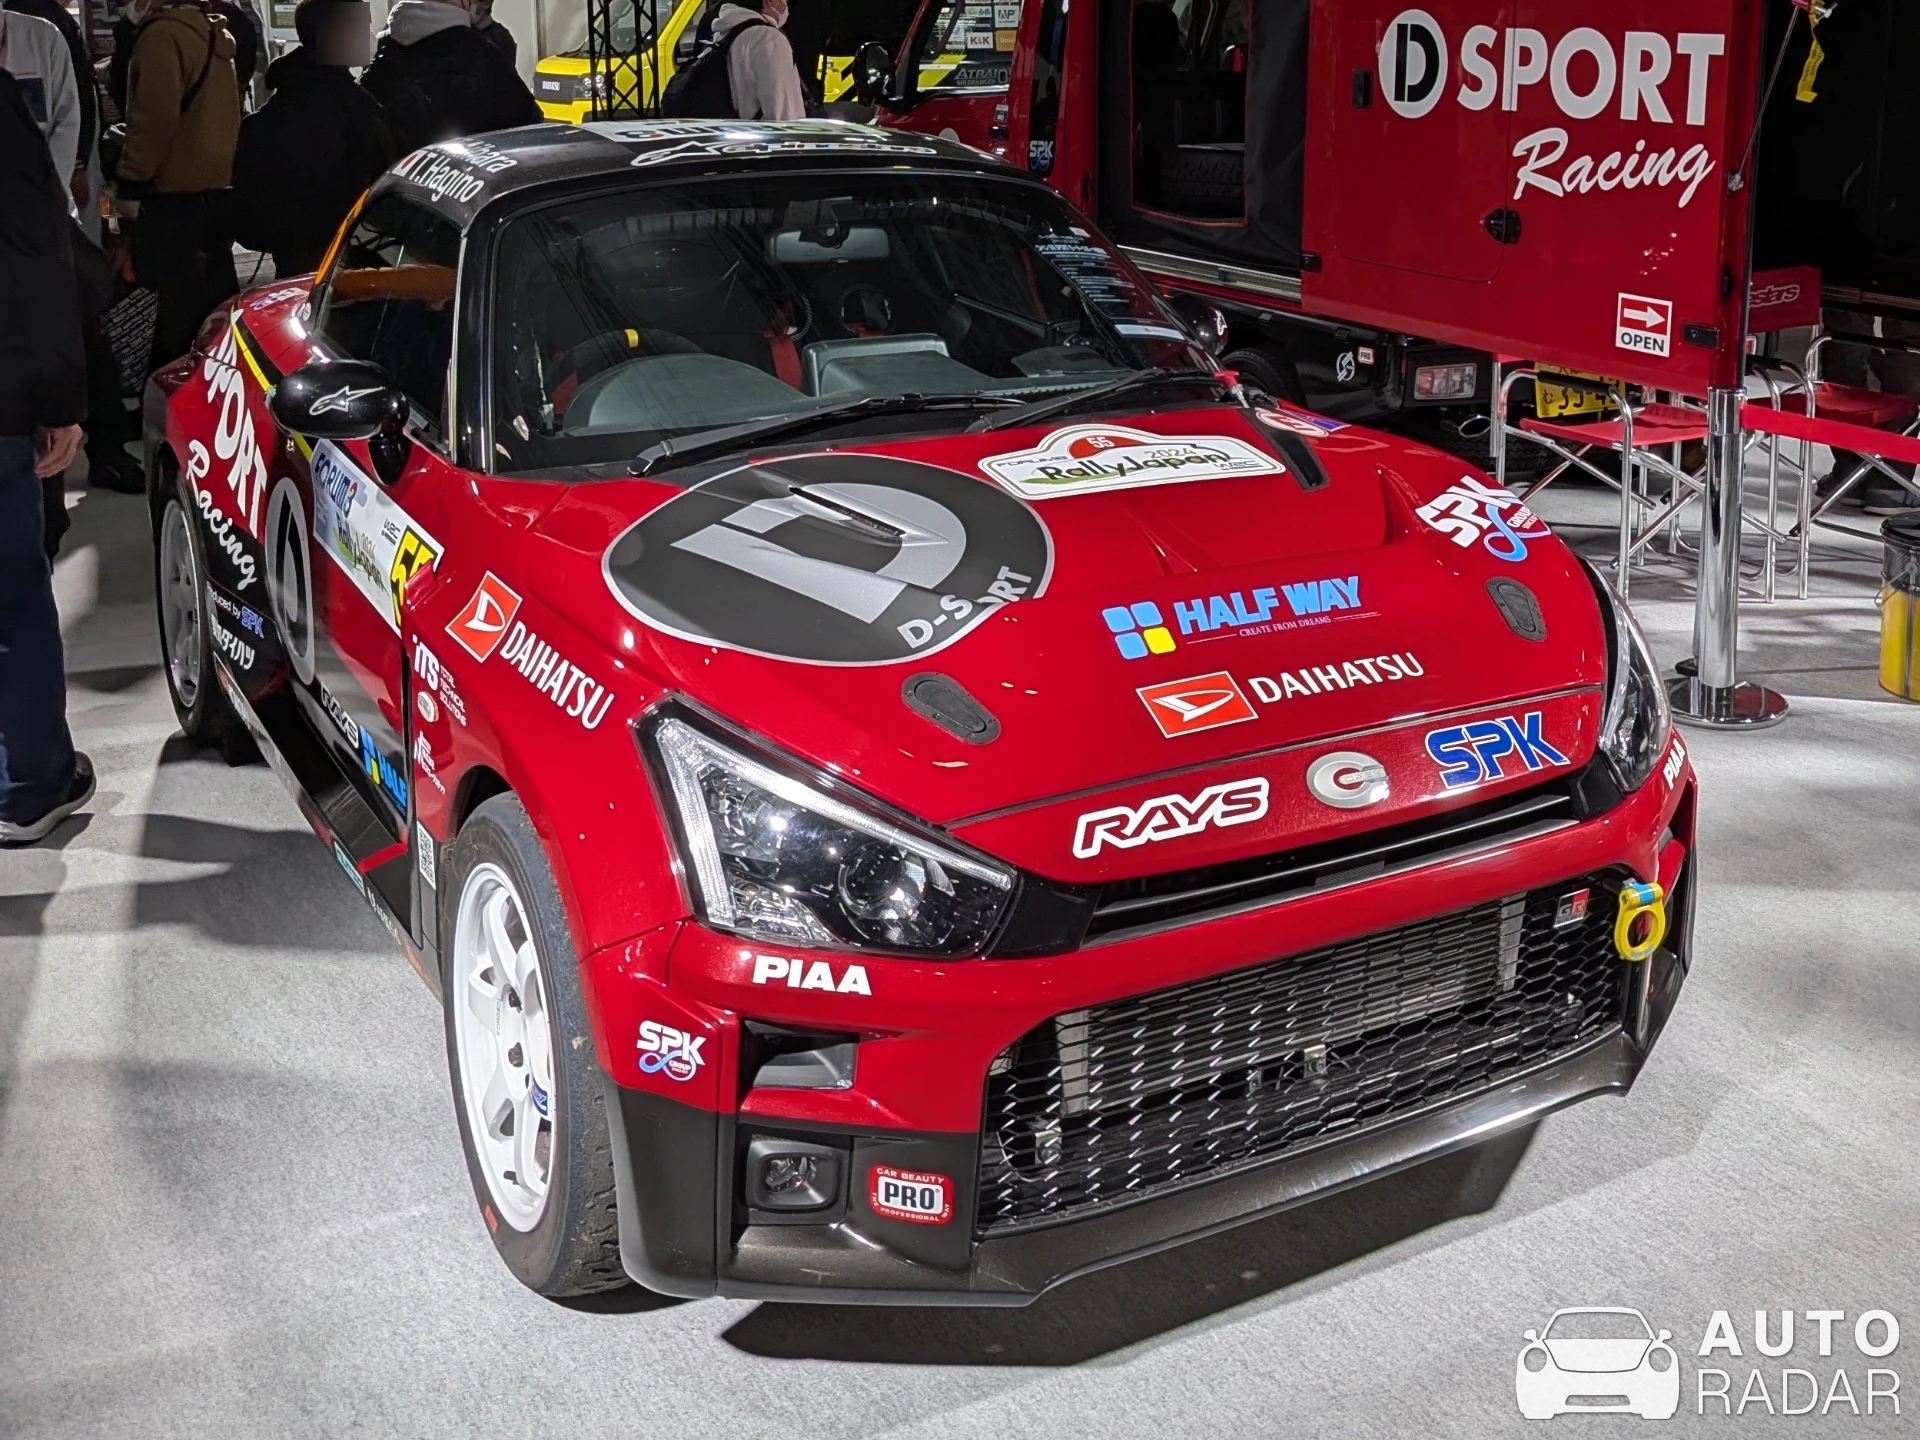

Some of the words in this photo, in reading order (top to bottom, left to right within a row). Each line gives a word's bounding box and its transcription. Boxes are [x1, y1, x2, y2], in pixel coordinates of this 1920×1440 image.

[1456, 24, 1725, 126] SPORT
[1029, 140, 1054, 158] SPK
[1512, 127, 1716, 208] Racing
[408, 152, 484, 202] T.Hagino
[1620, 332, 1665, 353] OPEN
[1085, 435, 1115, 449] 55
[1143, 447, 1194, 459] 2024
[186, 440, 258, 591] Racing
[1415, 475, 1518, 548] SPK
[241, 605, 264, 639] SPK
[1174, 588, 1279, 634] HALF
[1281, 576, 1362, 616] WAY
[1239, 624, 1272, 638] CREATE
[1273, 620, 1298, 632] FROM
[1299, 615, 1332, 628] DREAMS
[439, 664, 456, 689] TOTAL
[440, 677, 466, 713] TECHNICAL
[499, 620, 615, 730] DAIHATSU
[1248, 652, 1425, 704] DAIHATSU
[320, 681, 359, 749] RAYS
[440, 690, 467, 727] SOLUTIONS
[1425, 711, 1571, 789] SPK
[1663, 738, 1686, 791] PIAA
[377, 749, 407, 808] HALF
[1073, 777, 1269, 859] RAYS
[752, 955, 872, 996] PIAA
[637, 1020, 706, 1066] SPK
[877, 1167, 898, 1178] CAR
[901, 1172, 945, 1184] BEAUTY
[884, 1181, 935, 1210] PRO
[872, 1192, 880, 1207] THE
[880, 1207, 940, 1222] PROFESSIONAL
[941, 1203, 950, 1218] WAY
